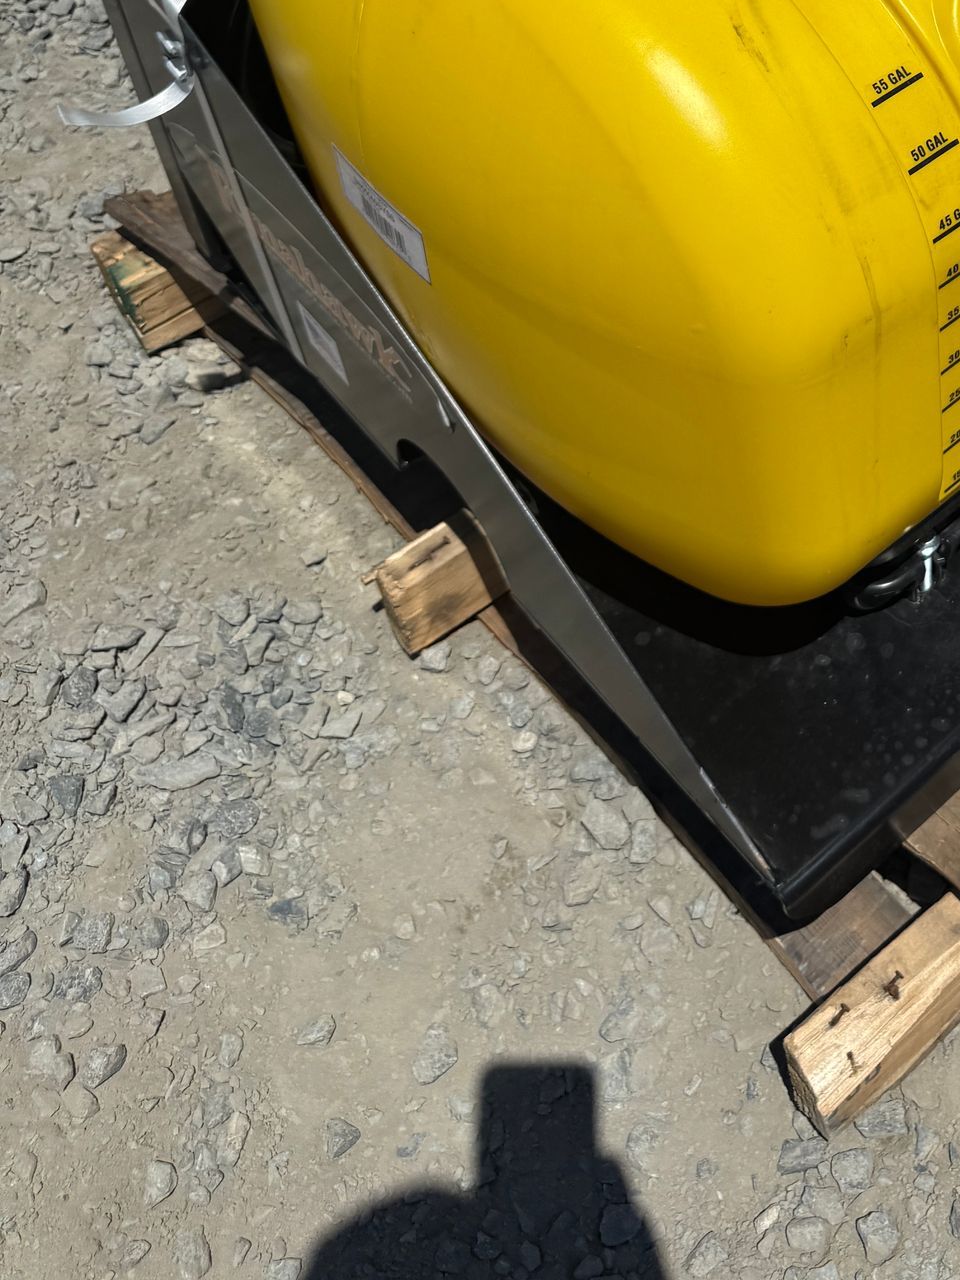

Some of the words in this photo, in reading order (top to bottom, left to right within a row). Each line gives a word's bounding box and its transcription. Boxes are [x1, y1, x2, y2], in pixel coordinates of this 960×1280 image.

[872, 77, 889, 95] 55
[889, 65, 912, 85] GAL
[910, 145, 926, 162] 50
[925, 131, 949, 152] GAL
[939, 214, 952, 231] 45
[946, 262, 959, 277] 40
[947, 306, 960, 321] 35
[948, 350, 960, 364] 30
[949, 387, 960, 402] 25
